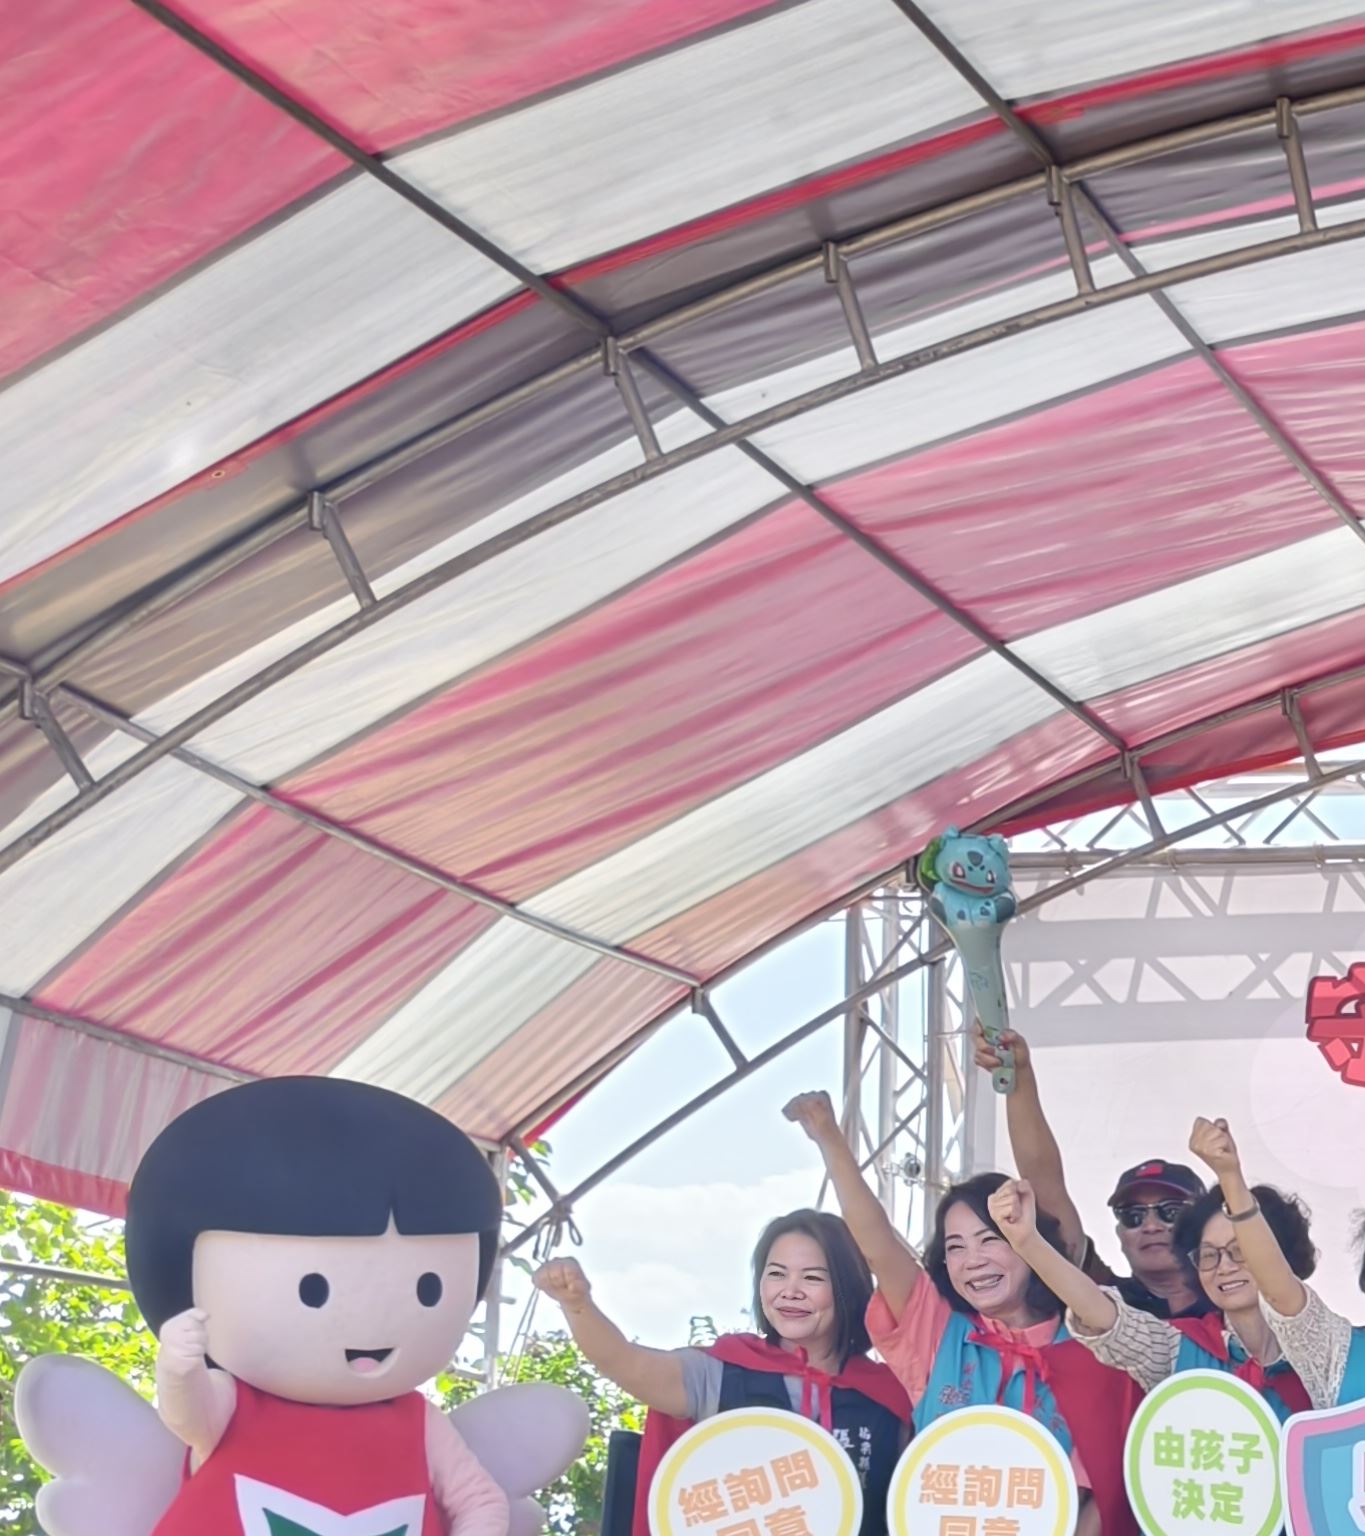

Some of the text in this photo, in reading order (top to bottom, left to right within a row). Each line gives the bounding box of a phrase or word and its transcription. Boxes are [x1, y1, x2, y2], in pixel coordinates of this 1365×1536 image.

[1153, 1425, 1264, 1475] 由孩子
[677, 1449, 819, 1526] 經詢問
[920, 1464, 1046, 1511] 經詢問
[1172, 1479, 1244, 1525] 決定
